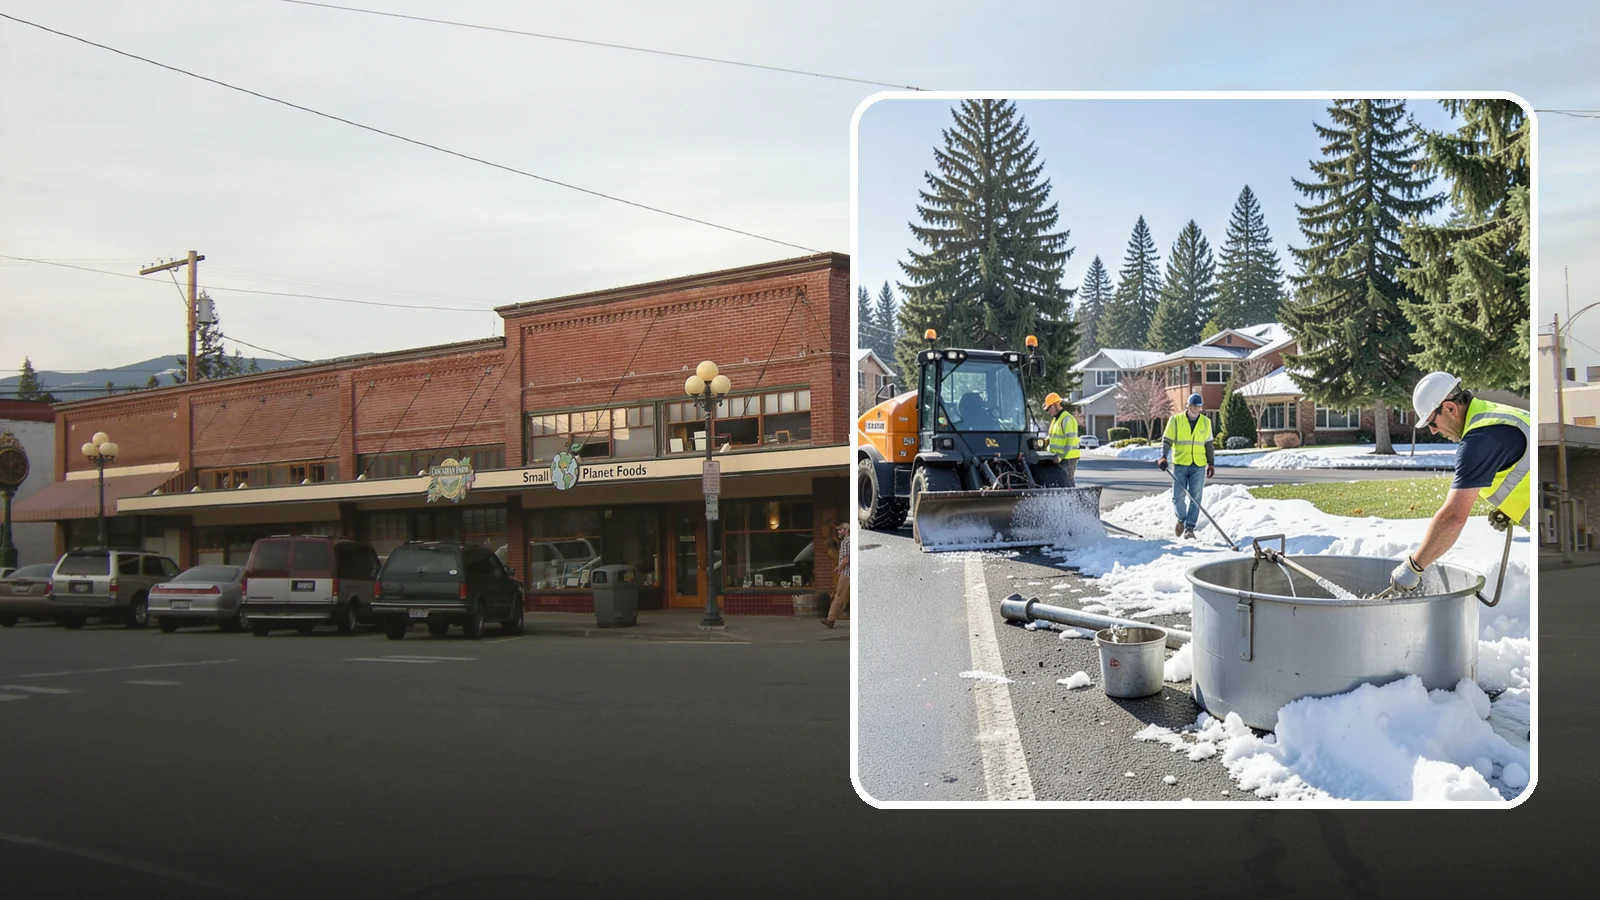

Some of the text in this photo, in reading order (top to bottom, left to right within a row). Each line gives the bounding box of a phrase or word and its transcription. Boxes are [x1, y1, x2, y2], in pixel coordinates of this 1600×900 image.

[431, 465, 469, 475] CASCADIAN FARM
[523, 464, 647, 483] Small Planet Foods
